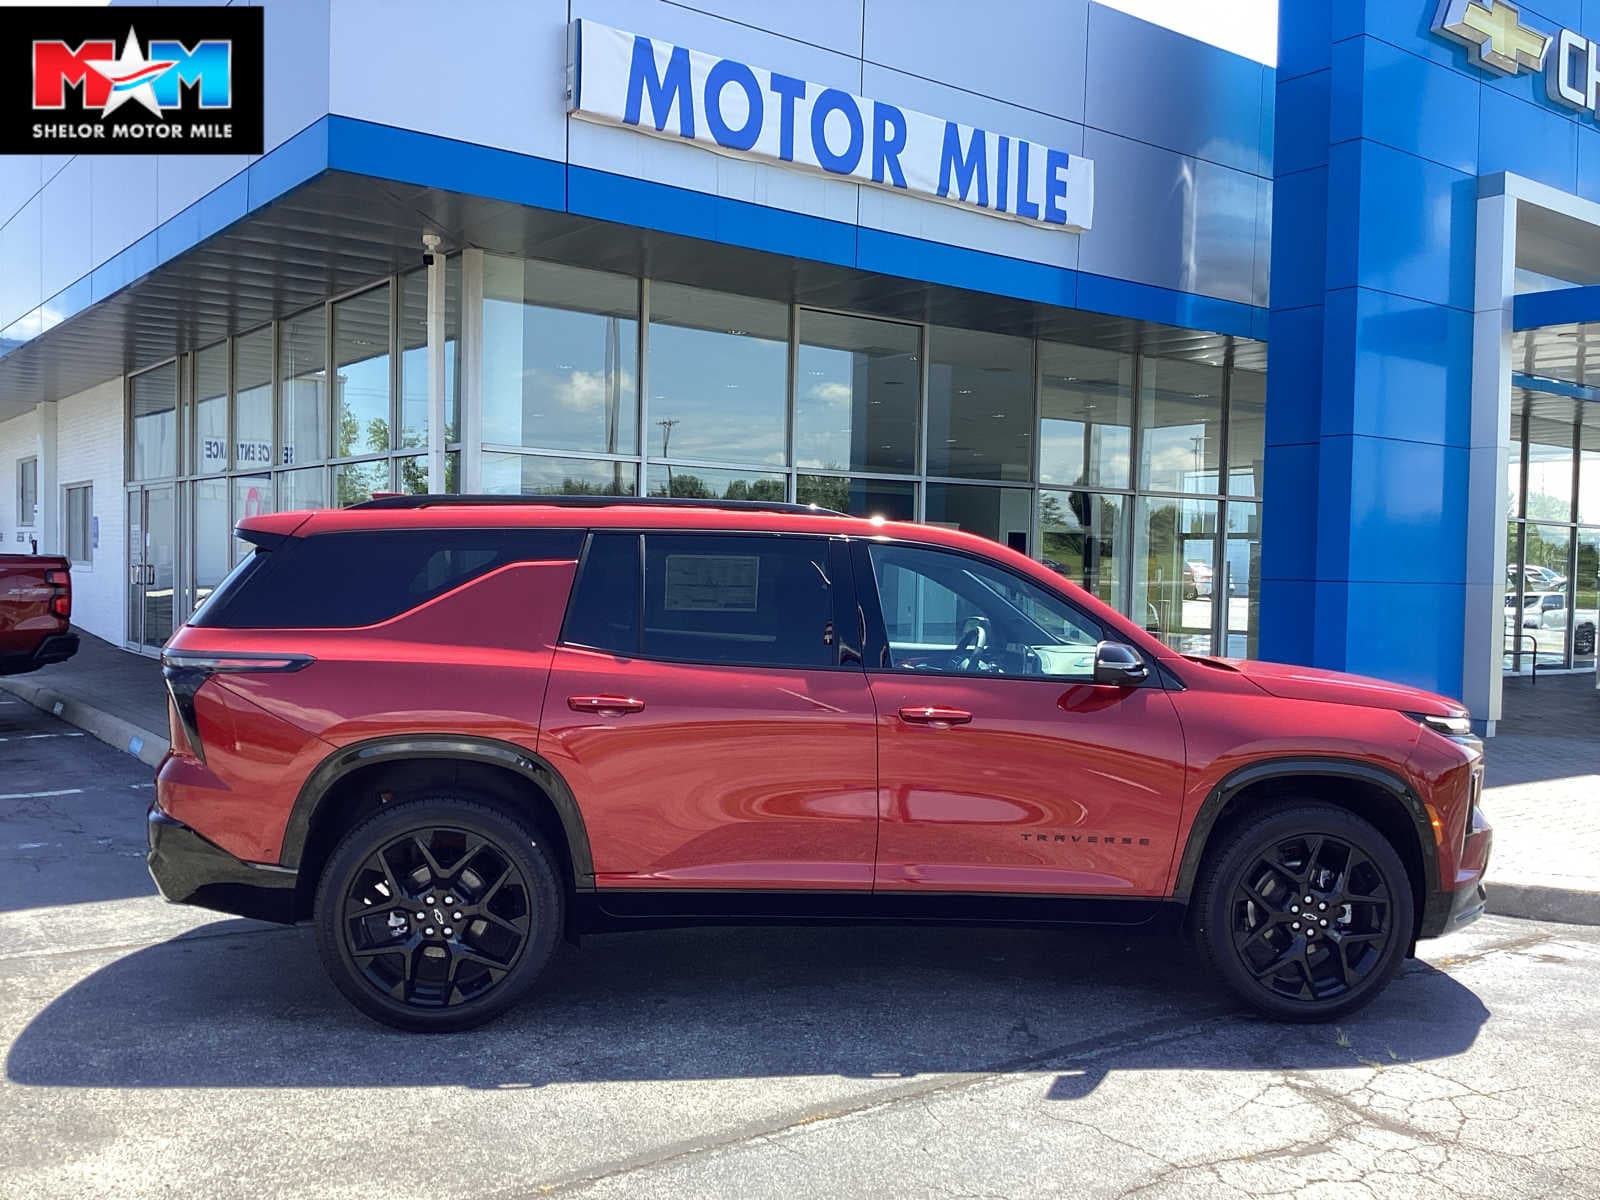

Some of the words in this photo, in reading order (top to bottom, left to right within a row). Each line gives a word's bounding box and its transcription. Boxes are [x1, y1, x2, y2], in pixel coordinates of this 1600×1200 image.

[622, 35, 908, 189] MOTOR
[937, 120, 1069, 225] MILE
[1021, 833, 1150, 846] TRAVERSE
